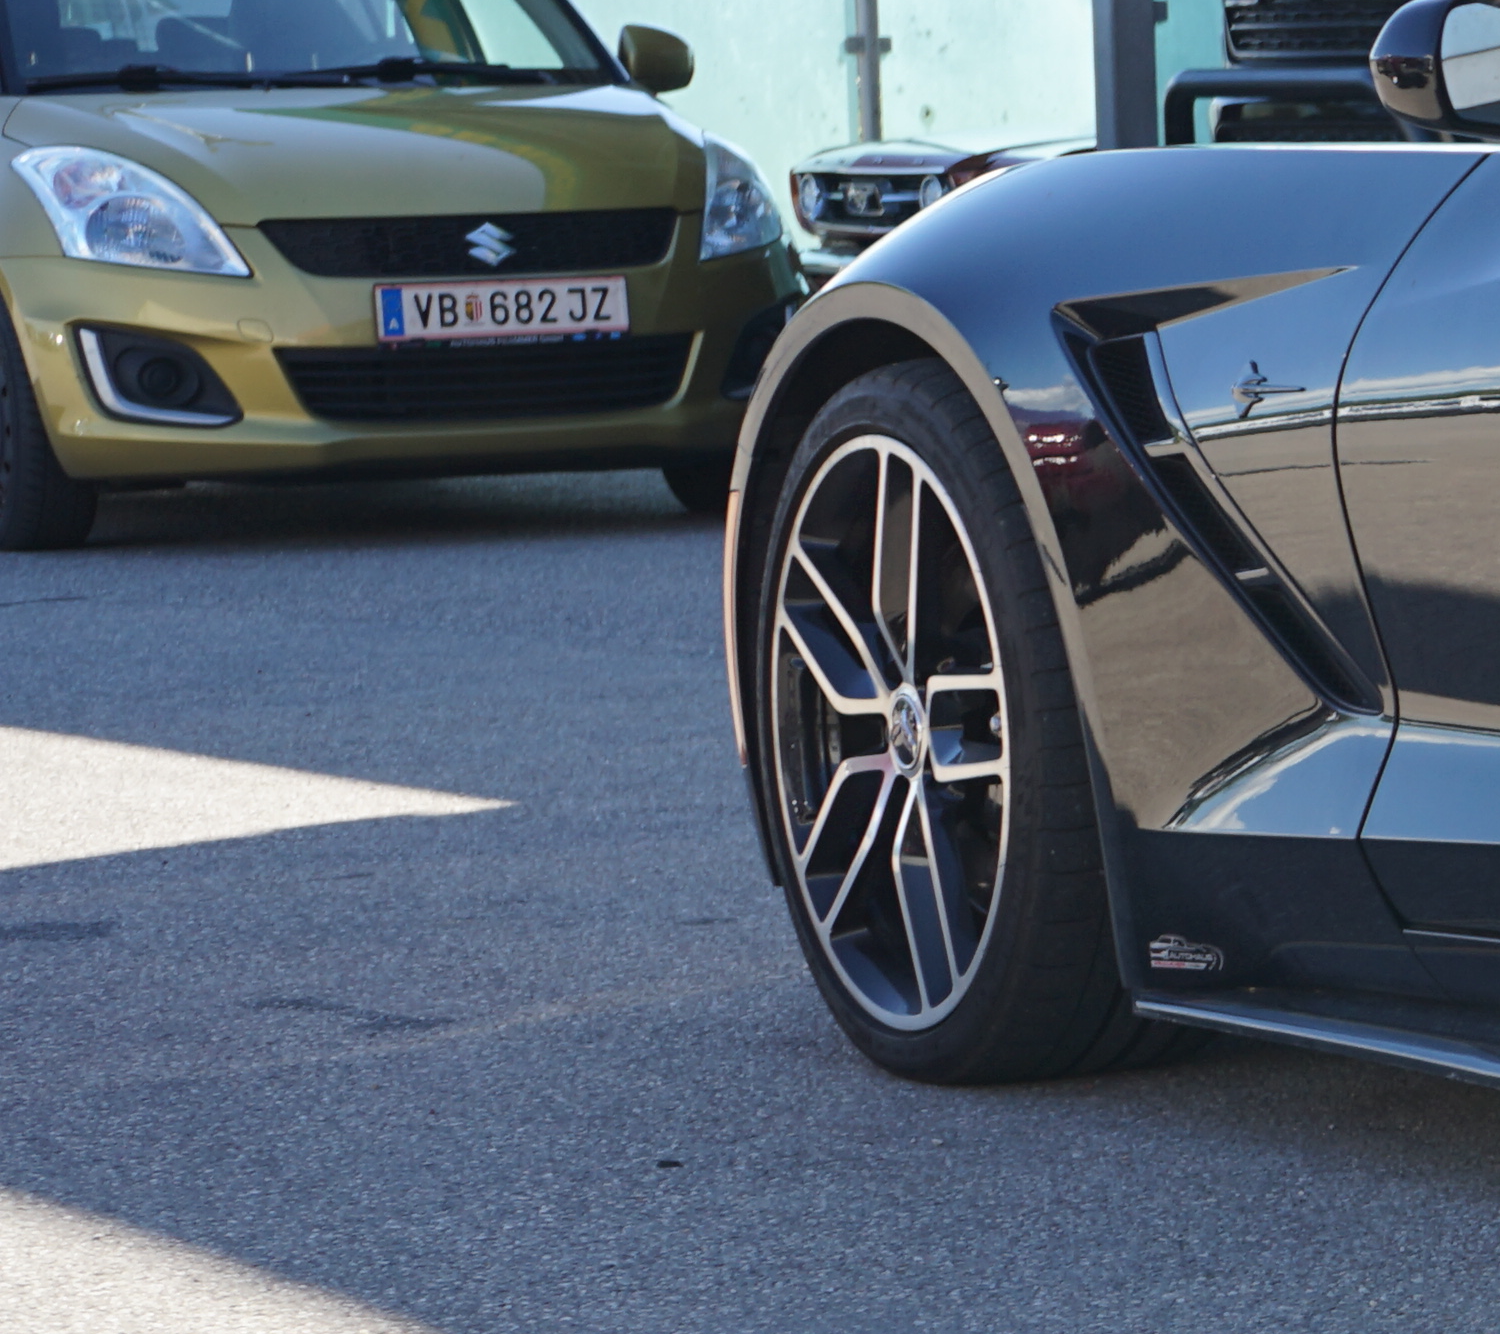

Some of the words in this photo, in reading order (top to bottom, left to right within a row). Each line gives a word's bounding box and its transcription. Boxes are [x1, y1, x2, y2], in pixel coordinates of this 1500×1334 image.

[413, 292, 459, 330] VB
[489, 288, 558, 326] 682
[567, 286, 612, 322] JZ
[388, 318, 400, 331] A
[1169, 951, 1213, 961] AUTOHAUS
